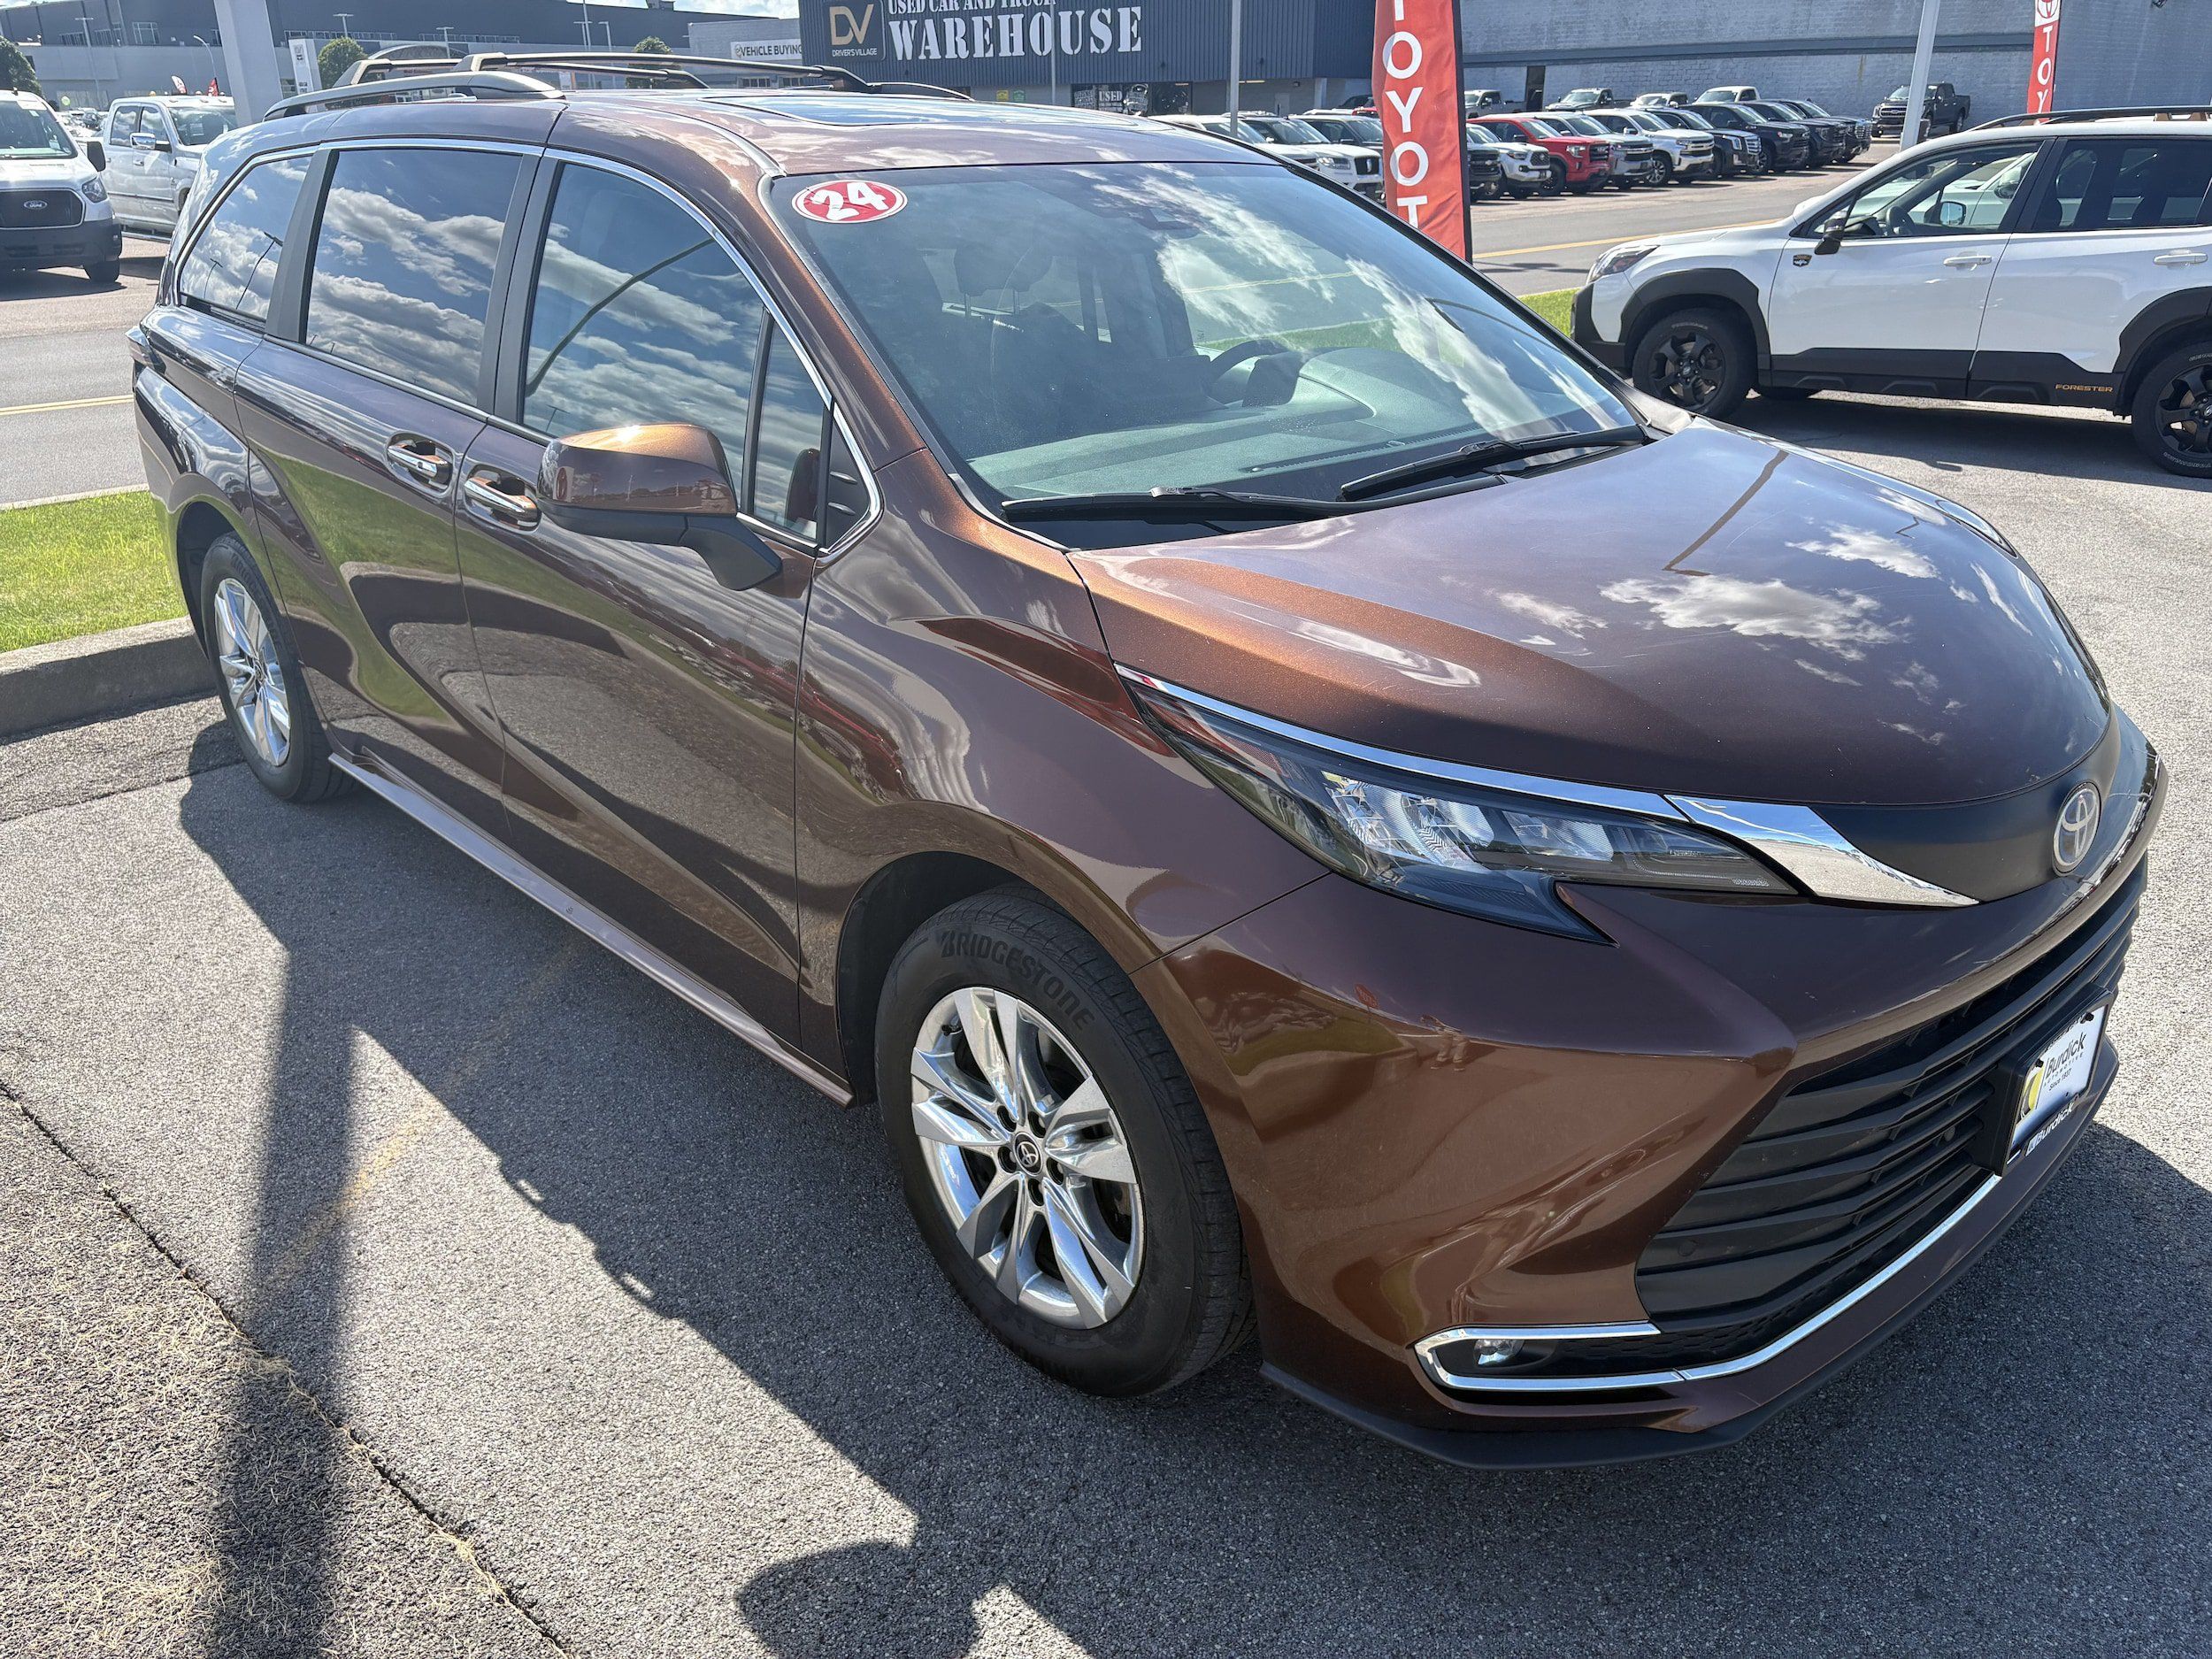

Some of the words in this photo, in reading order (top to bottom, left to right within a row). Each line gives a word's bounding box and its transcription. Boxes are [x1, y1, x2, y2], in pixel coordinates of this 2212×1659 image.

[741, 46, 772, 56] VEHICLE
[888, 6, 1141, 61] WAREHOUSE
[2037, 25, 2054, 114] TOY
[1098, 90, 1123, 102] USED
[1382, 0, 1429, 229] OYOT
[810, 181, 889, 221] 24
[941, 930, 1095, 1032] BRIDGESTONE
[2045, 1032, 2086, 1079] Burdick
